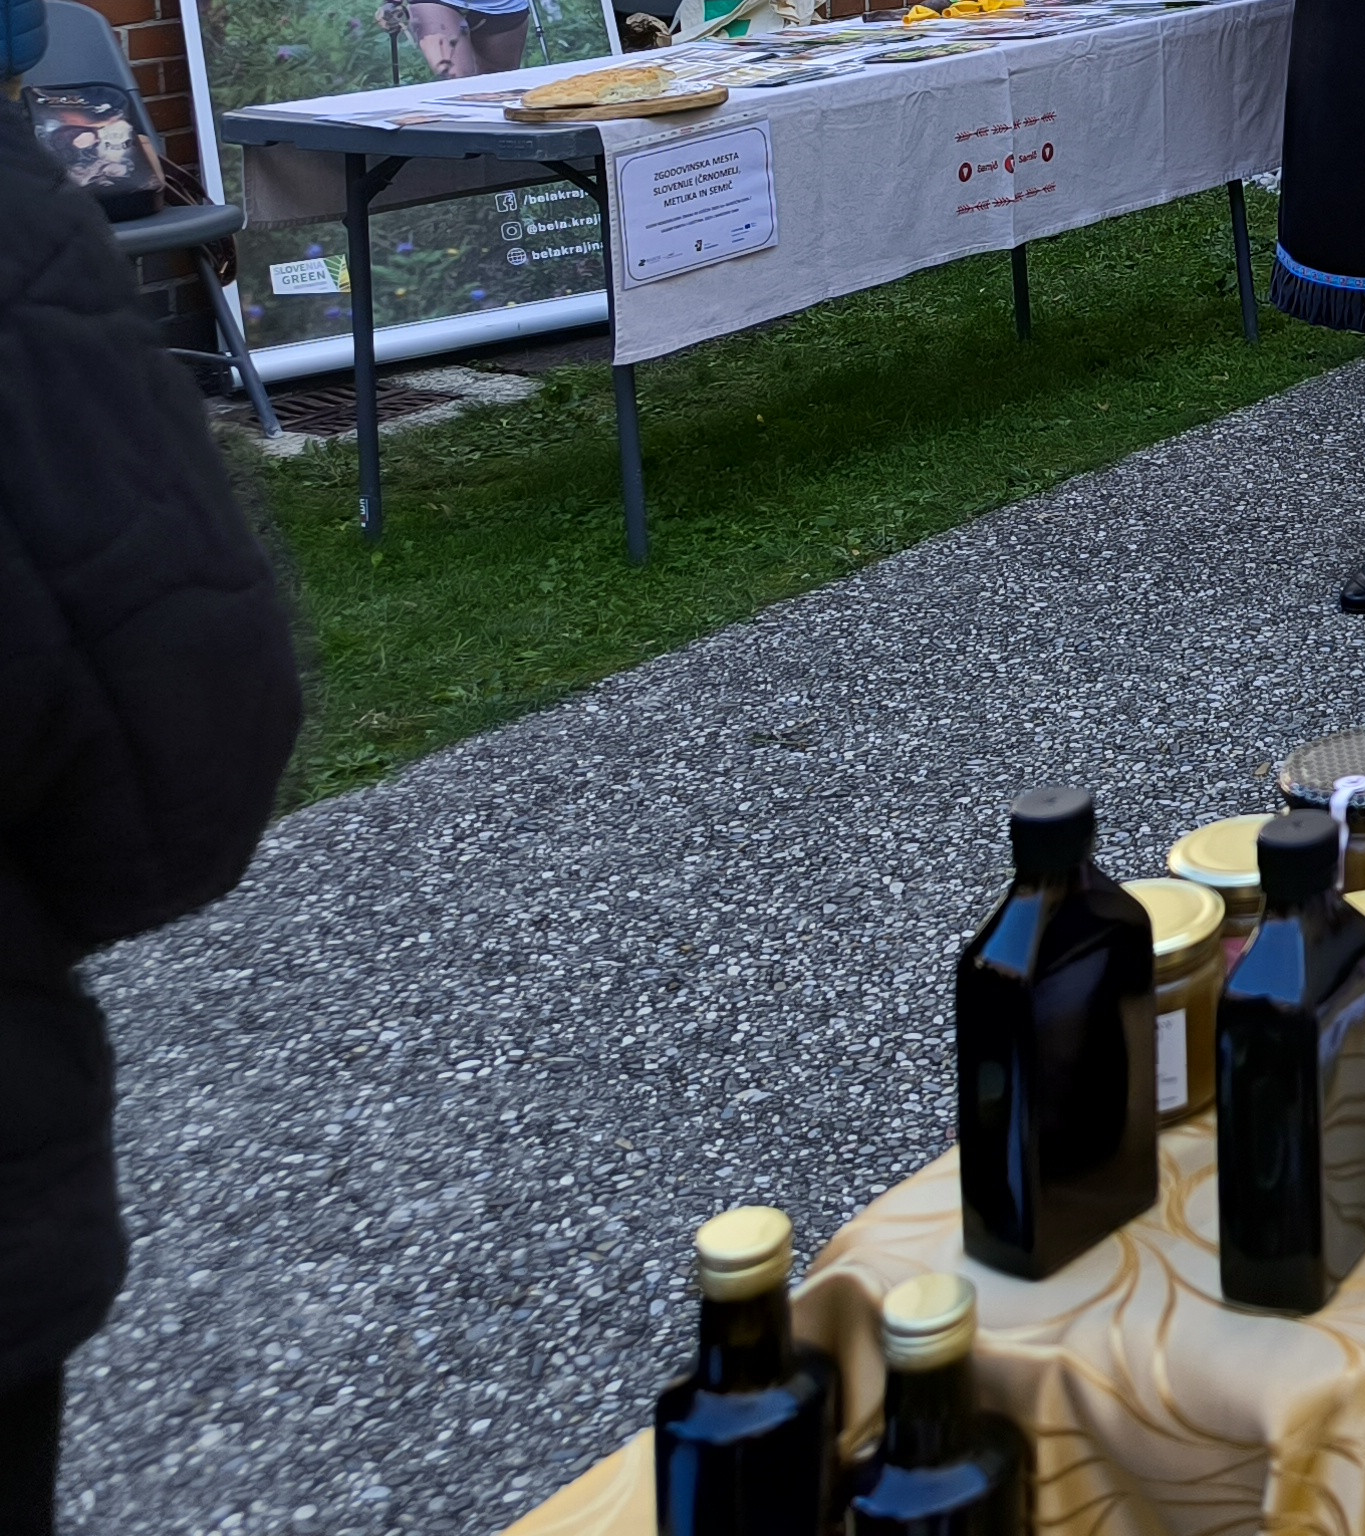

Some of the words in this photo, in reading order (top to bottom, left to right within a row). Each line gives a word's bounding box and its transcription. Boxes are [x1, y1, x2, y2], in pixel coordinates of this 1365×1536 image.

[653, 160, 711, 182] ZGODOVINSKA
[712, 151, 740, 166] MESTA
[653, 178, 693, 197] SLOVENIJE
[663, 190, 698, 208] METLIKA
[698, 188, 708, 199] IN
[709, 179, 734, 196] SEMIČ
[523, 189, 589, 206] /belakraj
[531, 241, 604, 260] belakrajin
[273, 261, 325, 275] SLOVENIA
[281, 270, 326, 285] GREEN
